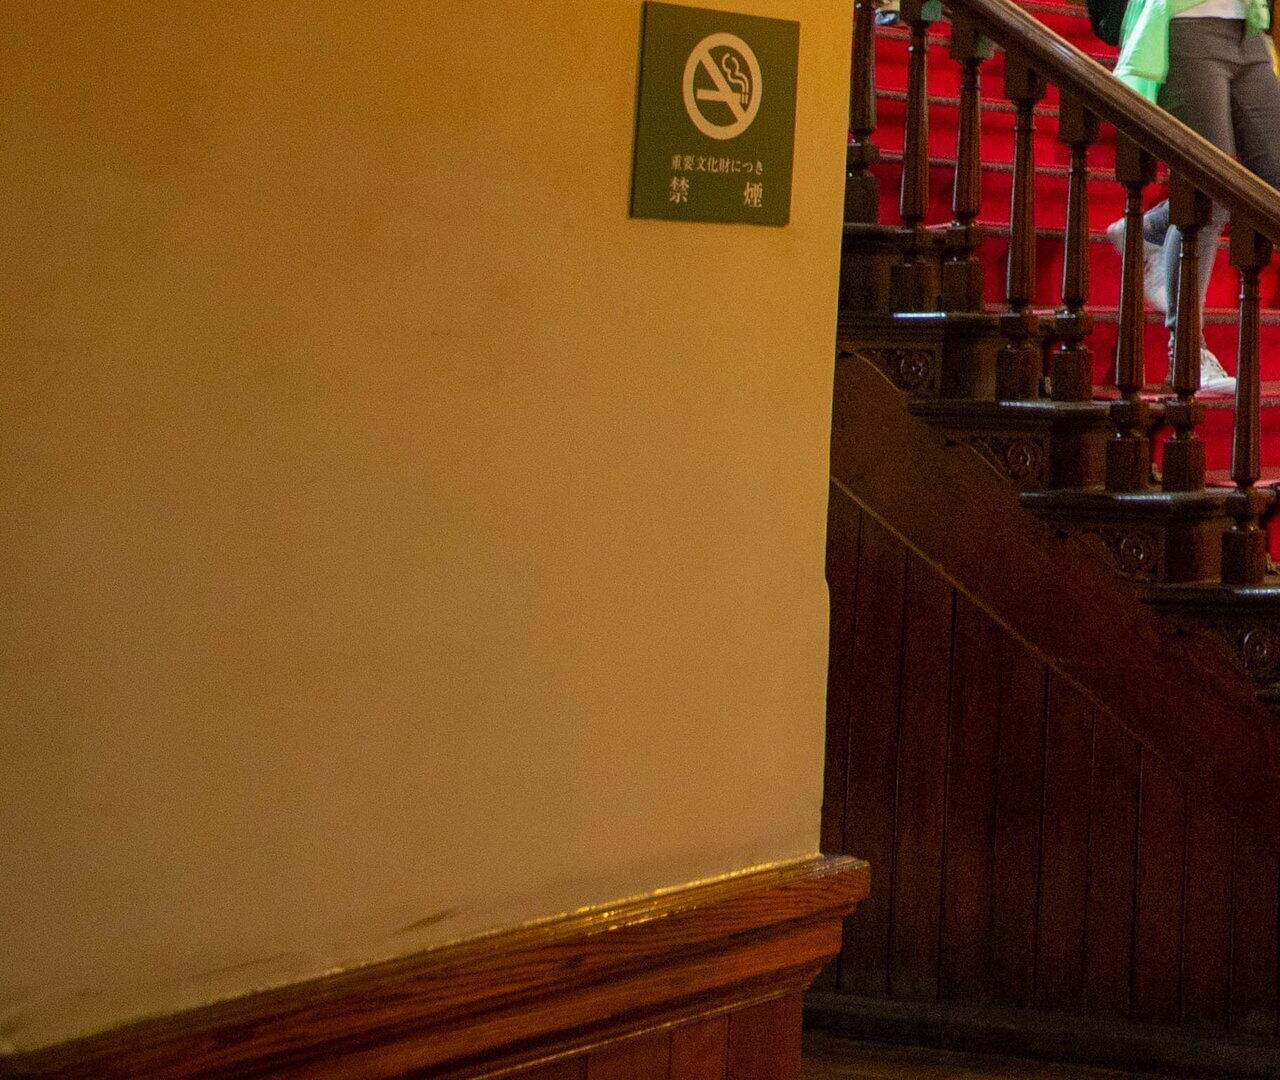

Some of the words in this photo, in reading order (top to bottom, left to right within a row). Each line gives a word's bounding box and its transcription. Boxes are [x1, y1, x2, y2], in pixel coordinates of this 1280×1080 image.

[671, 154, 763, 175] 重要文化財につき
